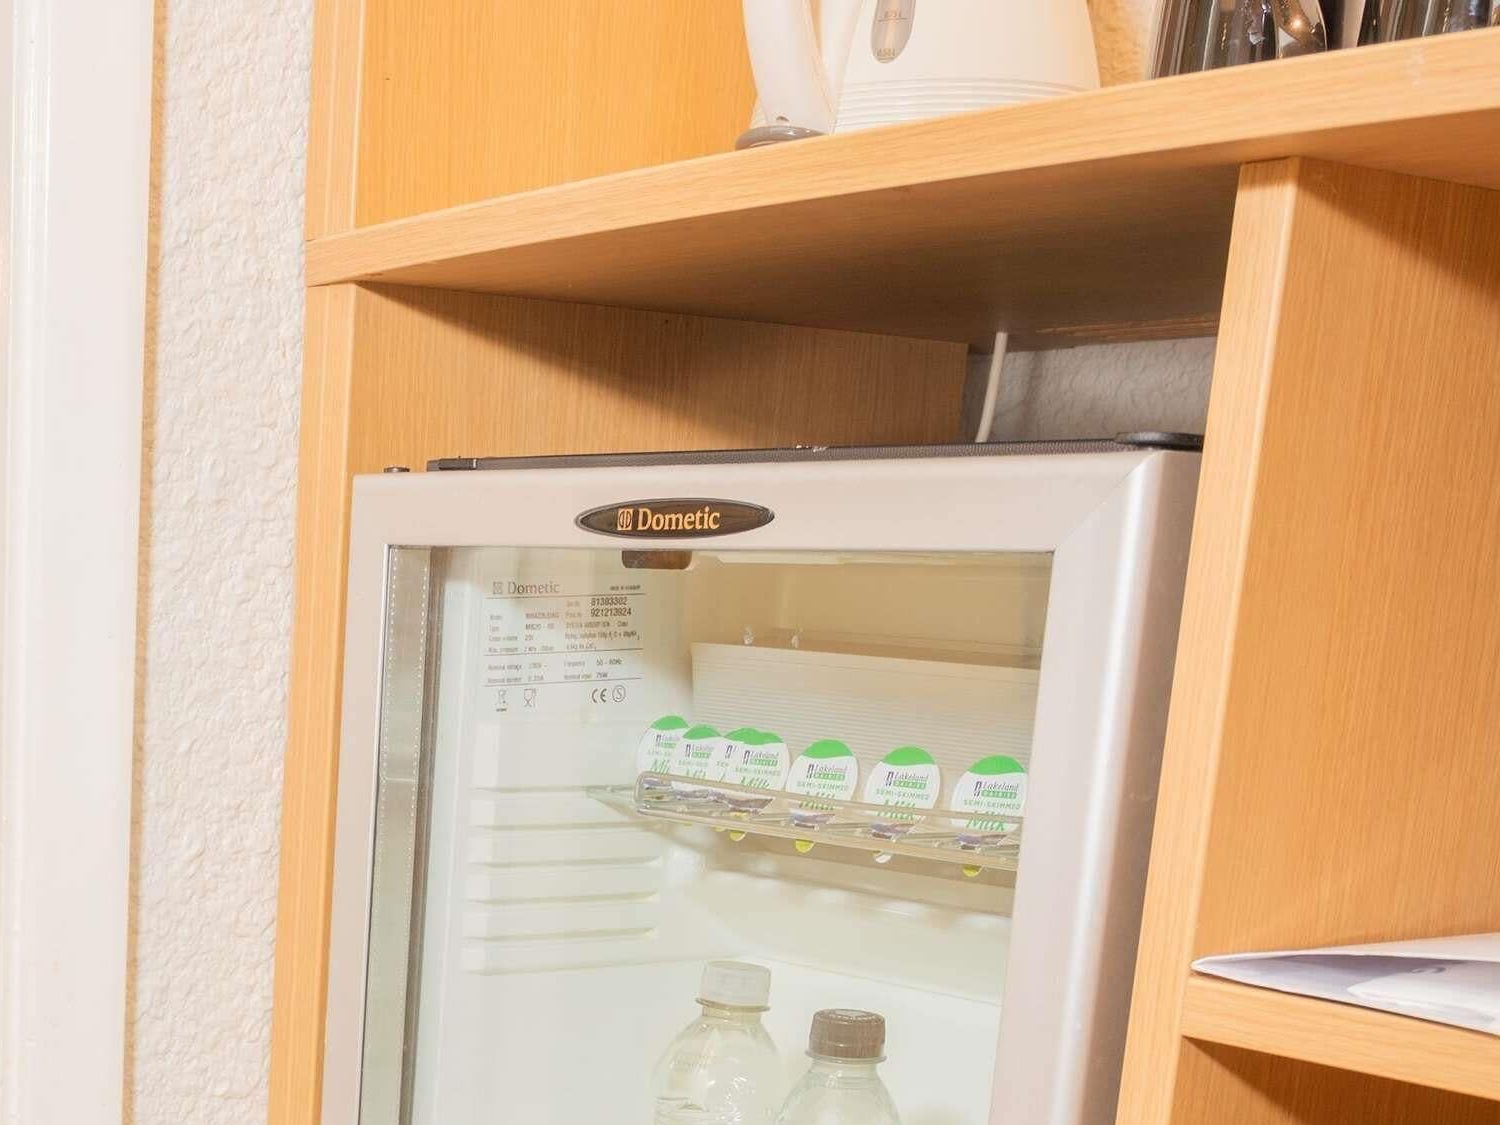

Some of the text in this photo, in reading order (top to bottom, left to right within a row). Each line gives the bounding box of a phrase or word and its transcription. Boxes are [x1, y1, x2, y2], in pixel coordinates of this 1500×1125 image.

[637, 506, 720, 531] Dometic
[507, 581, 560, 594] Dometic
[895, 772, 929, 781] Lakeland
[983, 781, 1019, 791] Lakeland
